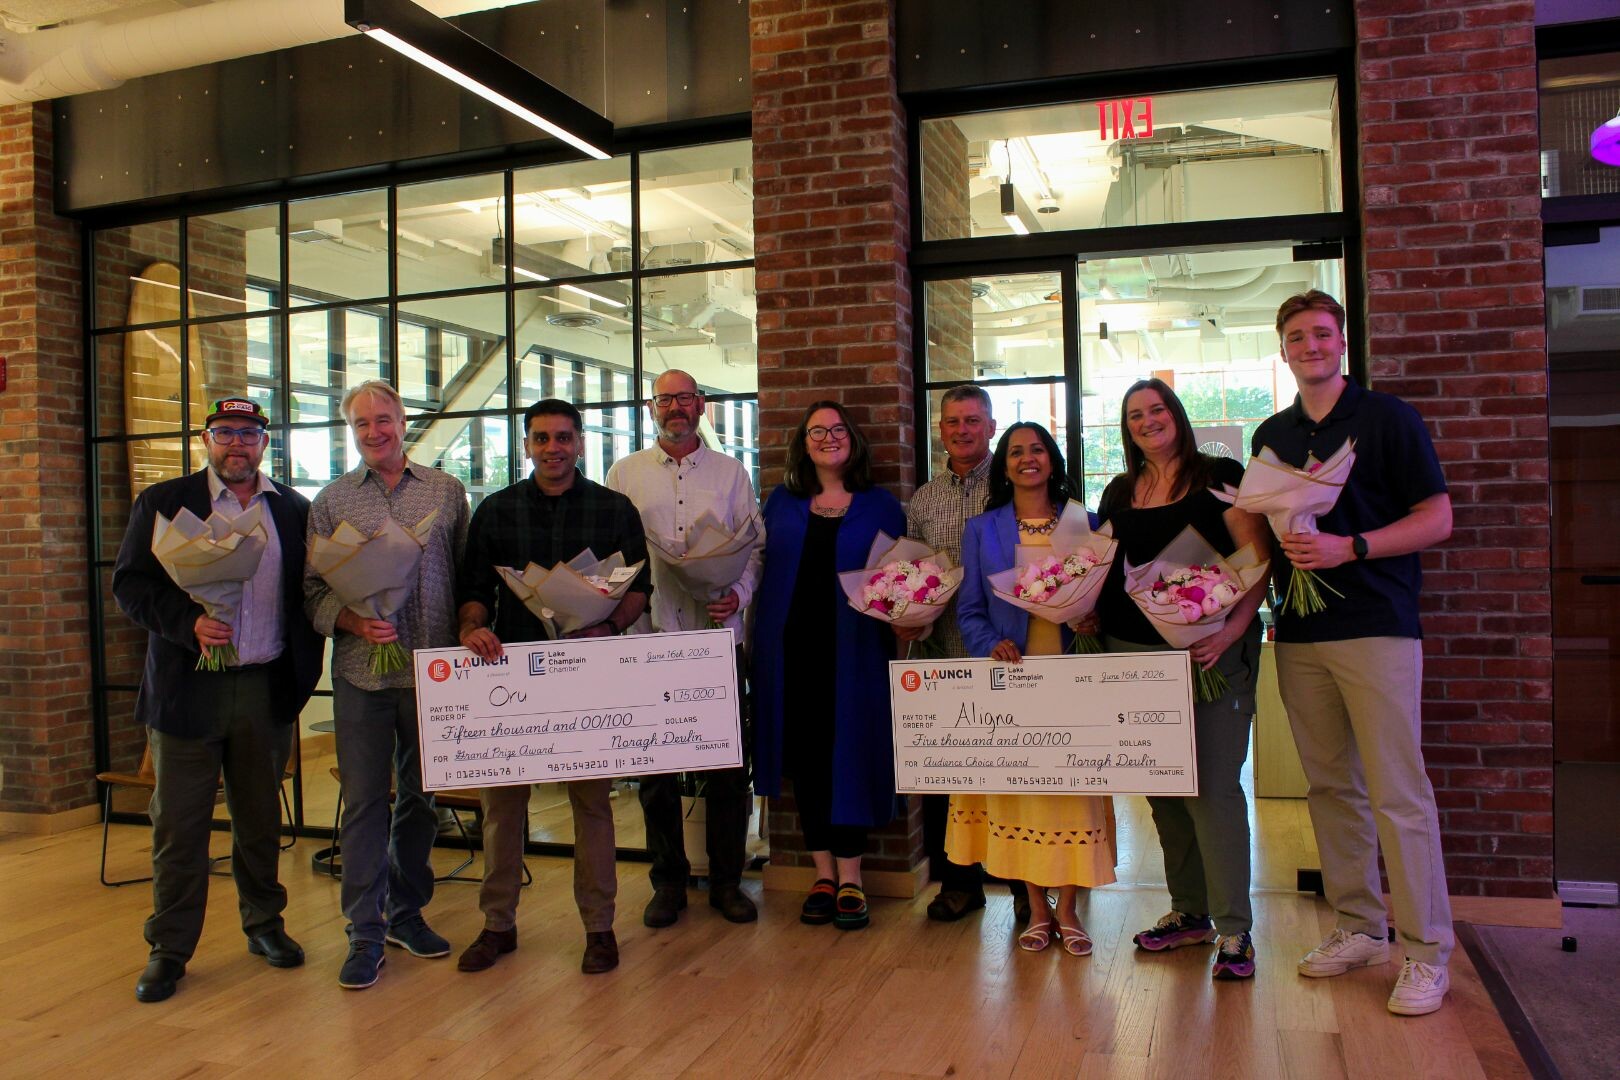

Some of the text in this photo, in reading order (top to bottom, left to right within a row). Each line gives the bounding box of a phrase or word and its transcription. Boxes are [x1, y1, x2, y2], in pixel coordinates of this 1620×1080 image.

[548, 650, 566, 658] Lake
[619, 656, 638, 664] DATE
[646, 650, 665, 664] June
[687, 647, 711, 657] 2026
[548, 656, 587, 667] Champlain
[454, 669, 470, 680] VT
[548, 666, 580, 674] Chamber
[923, 668, 973, 680] LAUNCH
[1007, 666, 1024, 674] Lake
[1008, 673, 1044, 682] Champlain
[1075, 675, 1093, 683] DATE
[1101, 672, 1120, 683] June
[1141, 670, 1165, 680] 2026
[924, 681, 939, 691] VT
[1008, 681, 1038, 689] Chamber
[488, 685, 528, 707] Oru
[663, 688, 715, 702] $ 15,000
[444, 705, 454, 713] TO
[456, 704, 470, 712] THE
[430, 713, 467, 722] ORDER OF
[665, 716, 698, 725] DOLLARS
[1117, 712, 1165, 724] $ 5,000
[441, 712, 633, 744] Fifteen thousand and 00/100
[912, 732, 1072, 747] Five thousand and 00/100
[1119, 739, 1152, 747] DOLLARS
[695, 742, 730, 751] SIGNATURE
[433, 743, 556, 763] FOR Grand Prize Award
[456, 767, 512, 779] 012345678
[547, 759, 609, 772] 9876543210
[631, 756, 655, 767] 1234
[904, 756, 1030, 768] FOR Audience Choice Award
[924, 776, 974, 785] 012345678
[1006, 776, 1063, 785] 9876543210
[1084, 776, 1108, 785] 1234
